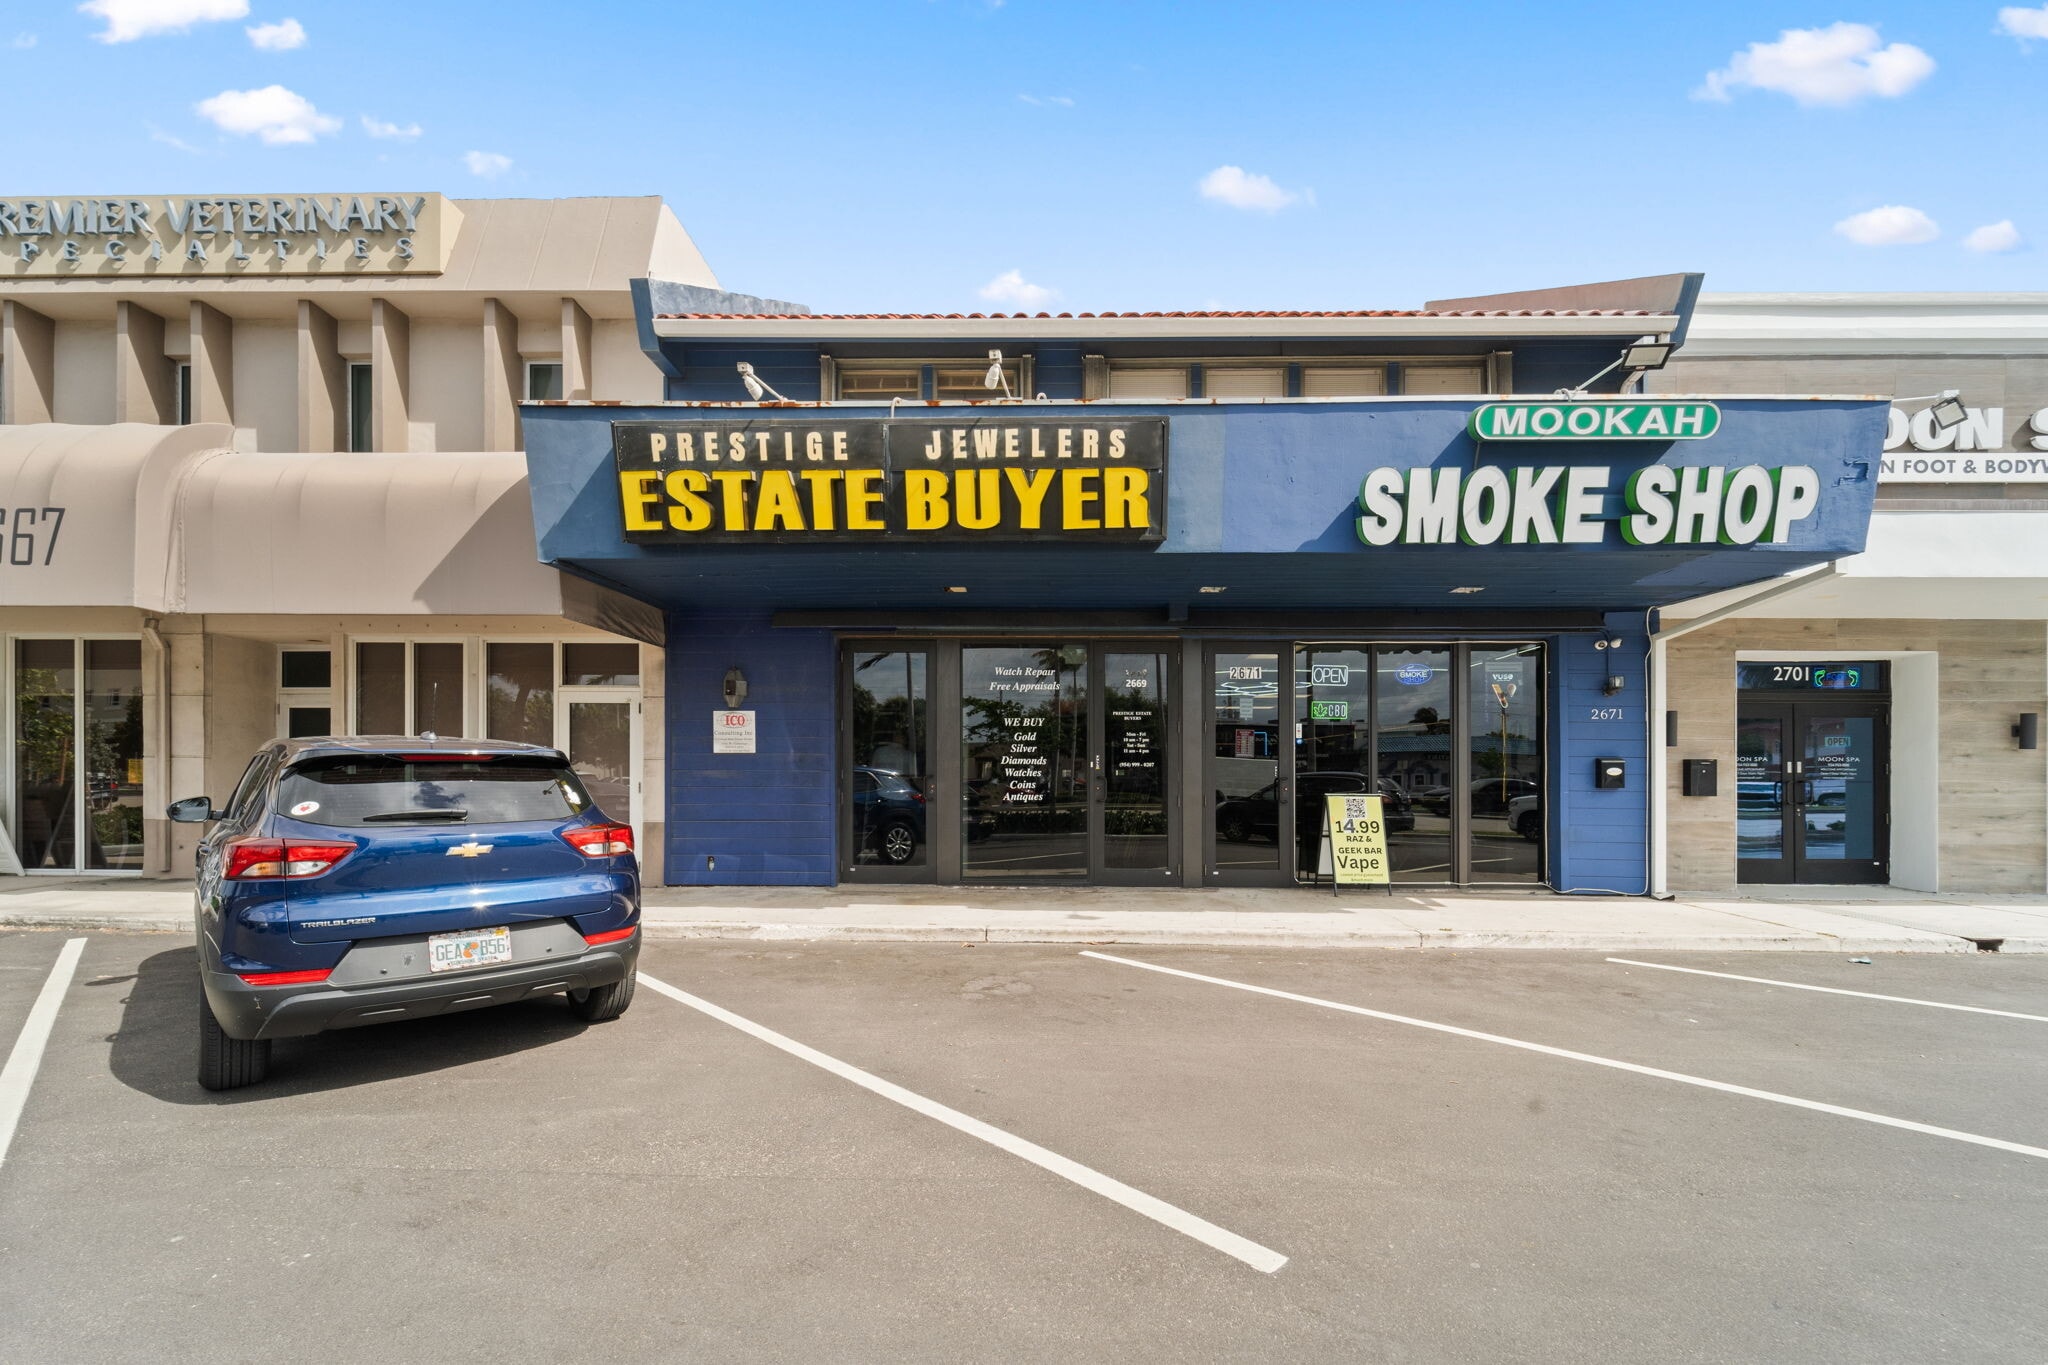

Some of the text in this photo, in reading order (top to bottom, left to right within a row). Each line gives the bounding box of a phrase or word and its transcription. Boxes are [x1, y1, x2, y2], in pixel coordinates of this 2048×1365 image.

[164, 197, 426, 236] VETERINARY
[1491, 407, 1705, 435] MOOKAH
[651, 428, 1127, 463] PRESTIGE JEWELERS
[1903, 459, 1957, 474] FOOT
[1963, 459, 1978, 474] &
[619, 467, 1151, 532] ESTATE BUYER
[1357, 463, 1821, 546] SMOKE SHOP
[0, 507, 66, 566] 67
[994, 667, 1056, 678] Watch Repair
[1230, 667, 1262, 679] 2671
[1313, 668, 1347, 683] OPEN
[1773, 666, 1810, 681] 2701
[989, 681, 1061, 693] Free Appraisals
[1125, 679, 1147, 688] 2669
[1591, 708, 1624, 720] 2671
[725, 715, 746, 726] ICO
[1003, 717, 1045, 727] WE BUY
[1013, 732, 1037, 741] Gold
[1827, 737, 1849, 746] OPEN
[1010, 743, 1038, 753] Silver
[1000, 756, 1048, 765] Diamonds
[1004, 768, 1042, 777] Watches
[1010, 780, 1037, 789] Coins
[1003, 792, 1044, 803] Antiques
[1335, 818, 1380, 834] 14.99
[1337, 855, 1379, 872] Vape
[300, 917, 377, 928] TRAILBLAZER
[435, 942, 463, 962] GEA
